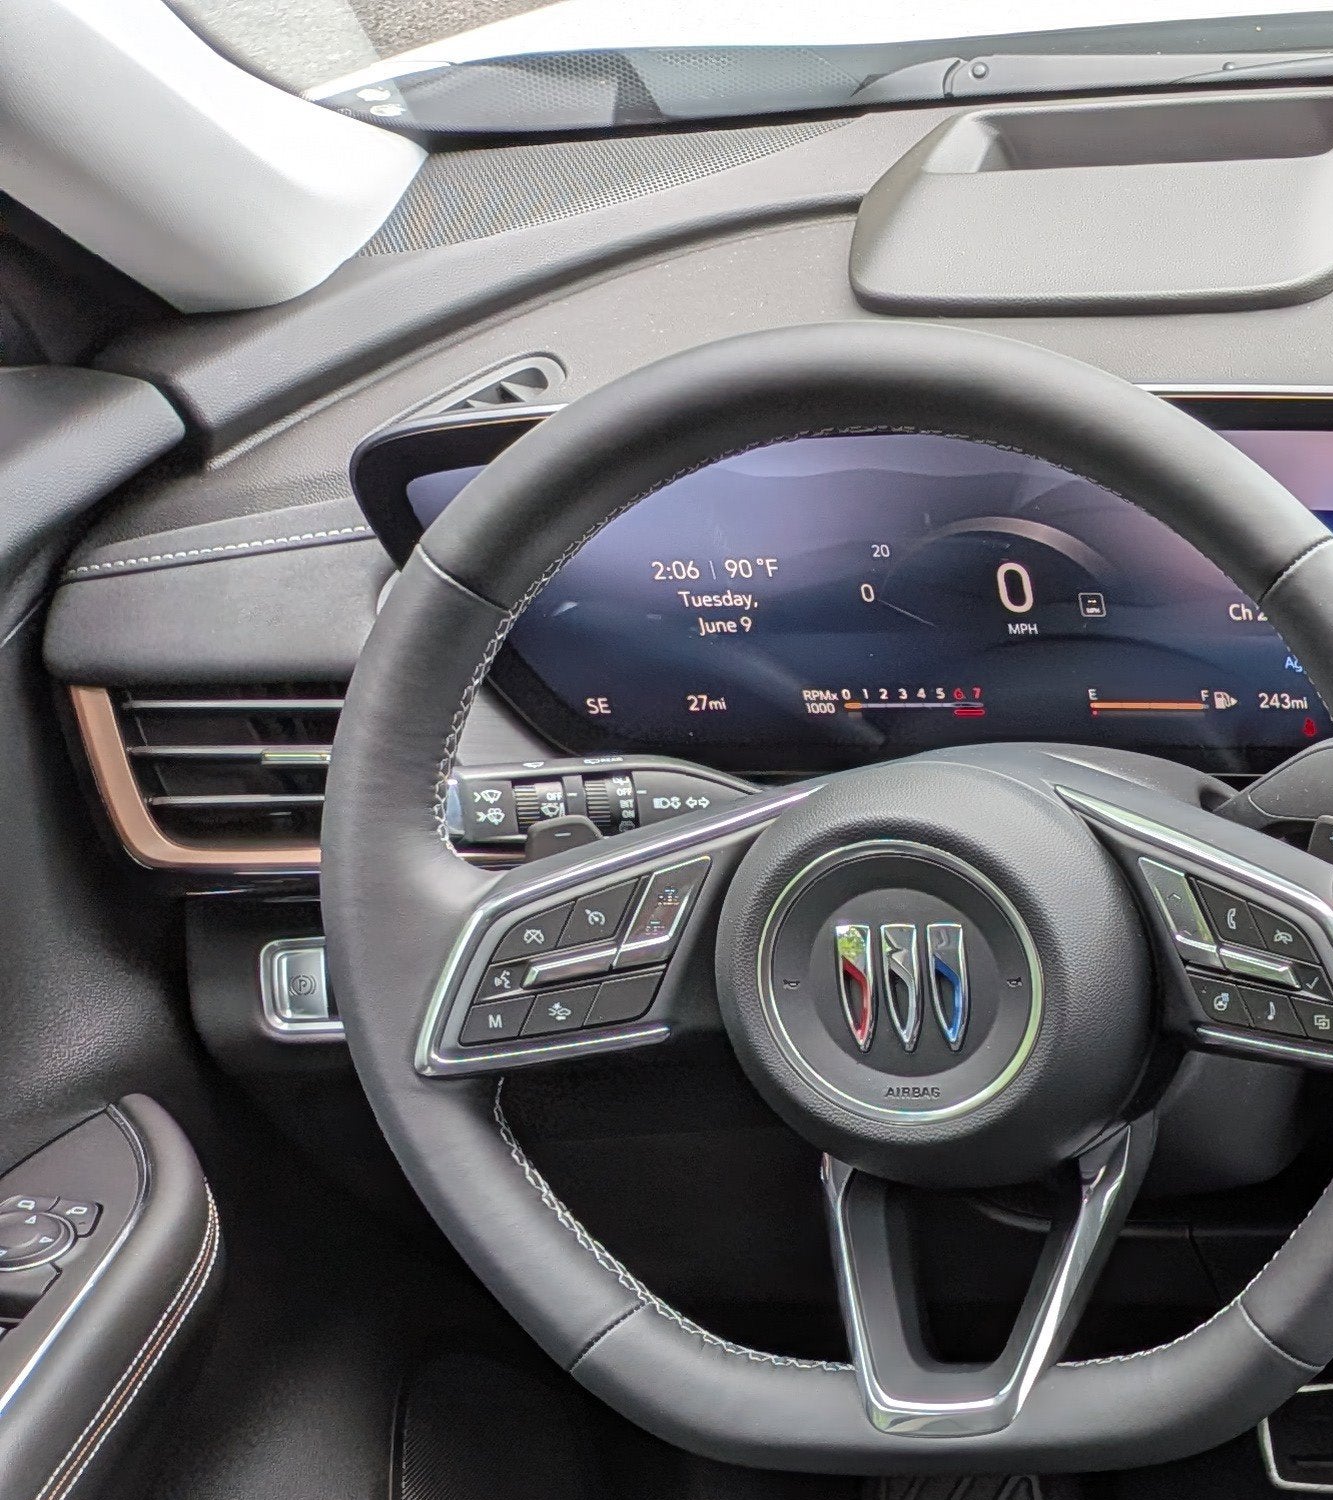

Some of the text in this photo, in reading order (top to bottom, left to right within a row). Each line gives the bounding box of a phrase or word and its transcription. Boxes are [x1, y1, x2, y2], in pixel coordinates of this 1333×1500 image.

[872, 544, 890, 559] 20
[651, 560, 700, 580] 2:06
[861, 583, 875, 603] 0
[996, 561, 1034, 613] 0
[678, 590, 758, 610] Tuesday,
[1229, 603, 1252, 621] Ch
[698, 616, 752, 637] June 9
[1007, 623, 1039, 636] MPH
[841, 688, 852, 700] 0
[879, 688, 889, 700] 2
[898, 688, 908, 700] 3
[916, 688, 927, 700] 4
[935, 688, 946, 699] 5
[953, 688, 965, 700] 6
[972, 687, 982, 699] 7
[1088, 688, 1097, 700] E
[1201, 689, 1210, 702] F
[1258, 693, 1308, 710] 243mi
[586, 697, 611, 715] SE
[687, 695, 726, 713] 27mi
[805, 702, 836, 714] 1000
[546, 791, 563, 801] OFF
[616, 787, 632, 797] OFF
[488, 1013, 503, 1029] M
[884, 1085, 941, 1099] AIRBAG
